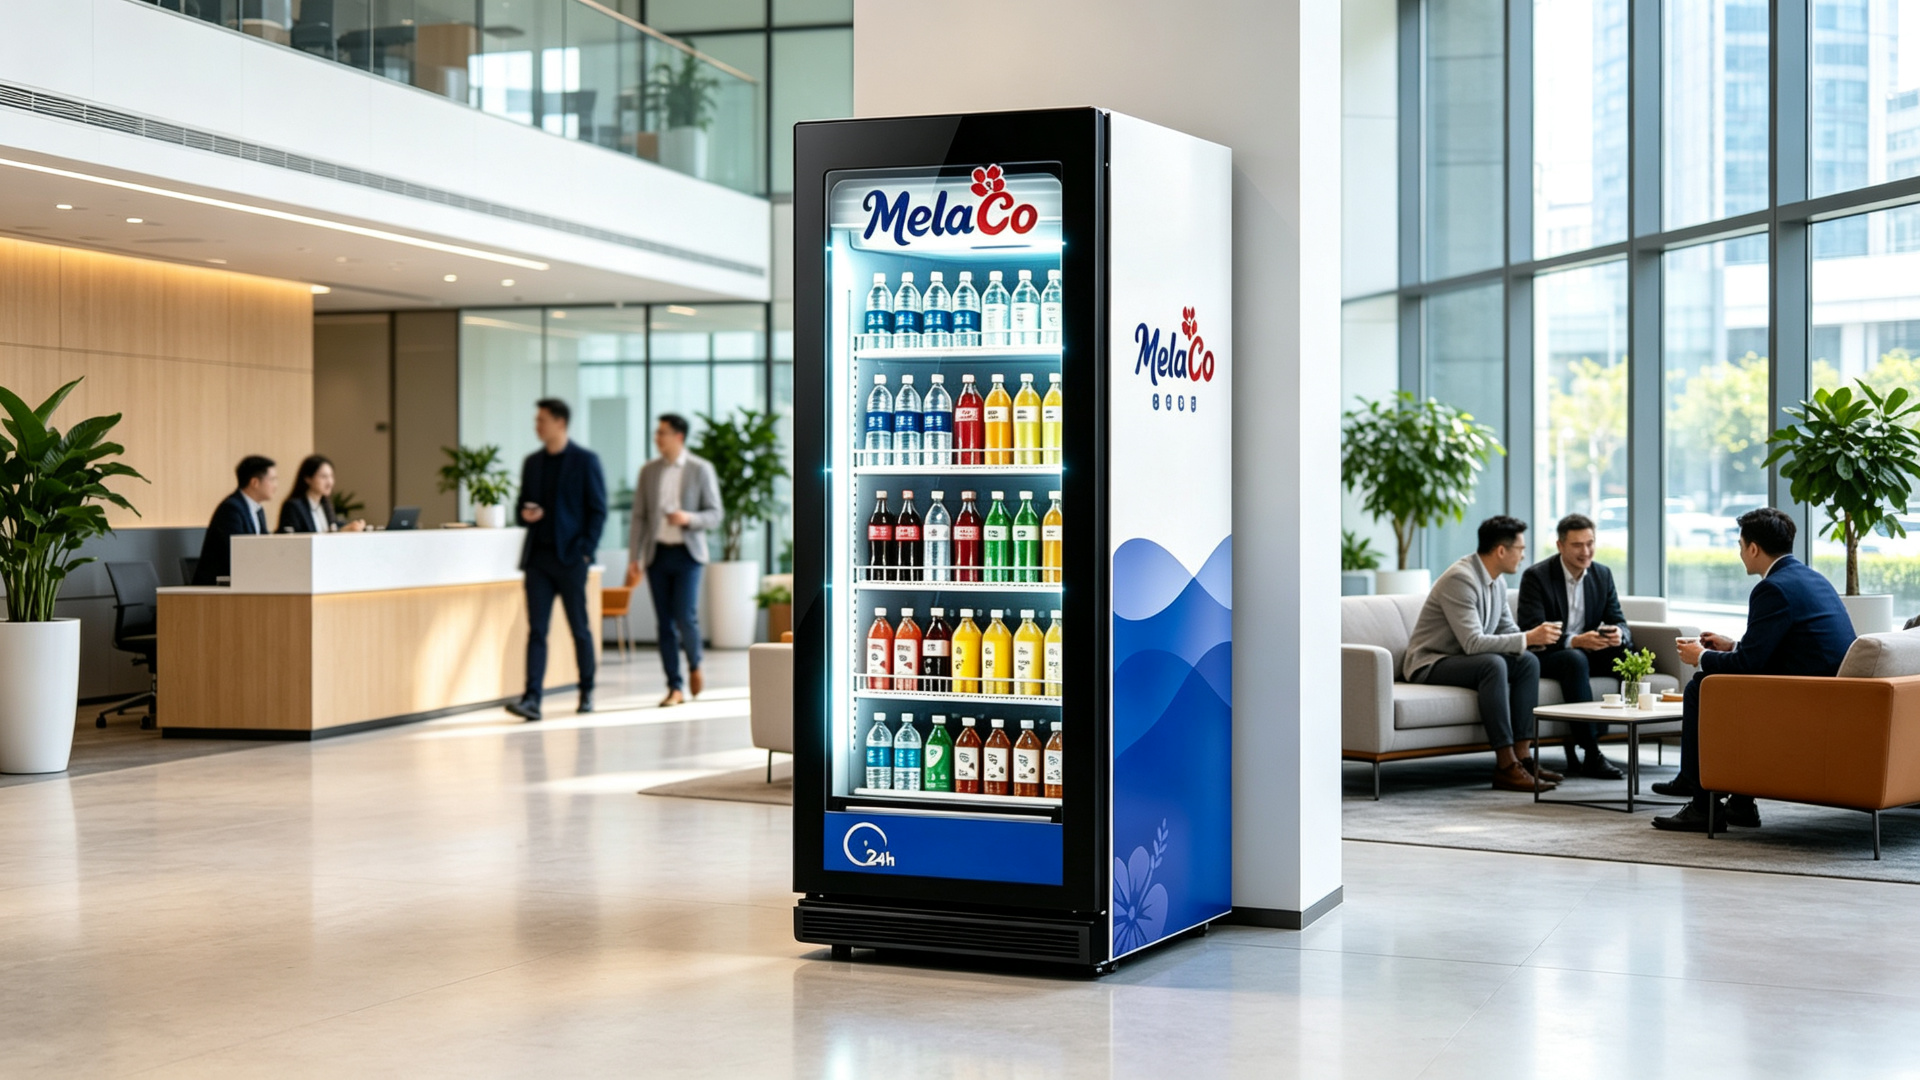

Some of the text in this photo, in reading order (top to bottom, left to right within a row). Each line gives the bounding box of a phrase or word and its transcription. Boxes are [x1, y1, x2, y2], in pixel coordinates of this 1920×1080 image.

[863, 189, 1038, 246] MelaCo
[1135, 322, 1214, 386] MelaCo
[866, 848, 895, 867] 24h
